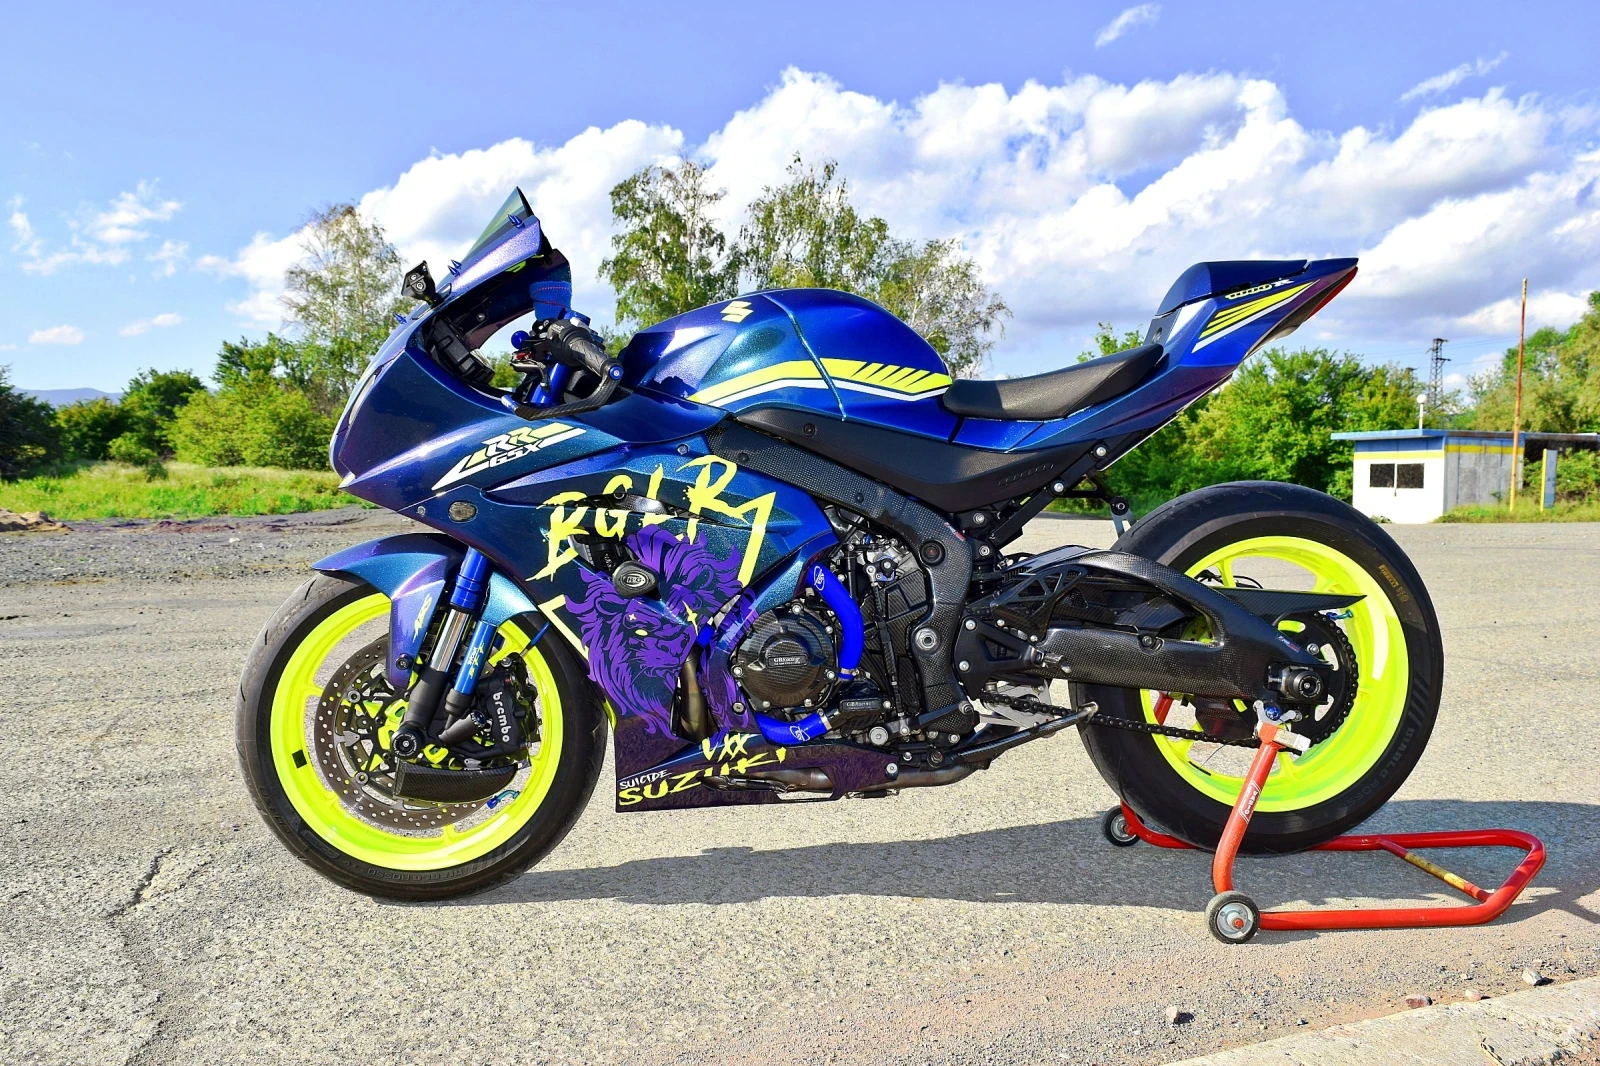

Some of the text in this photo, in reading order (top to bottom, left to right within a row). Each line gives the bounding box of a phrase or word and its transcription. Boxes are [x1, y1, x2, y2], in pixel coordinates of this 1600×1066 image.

[489, 441, 541, 468] GSX
[492, 692, 510, 743] brembo
[1379, 727, 1416, 779] DIABLO
[619, 769, 673, 790] SUICIDE
